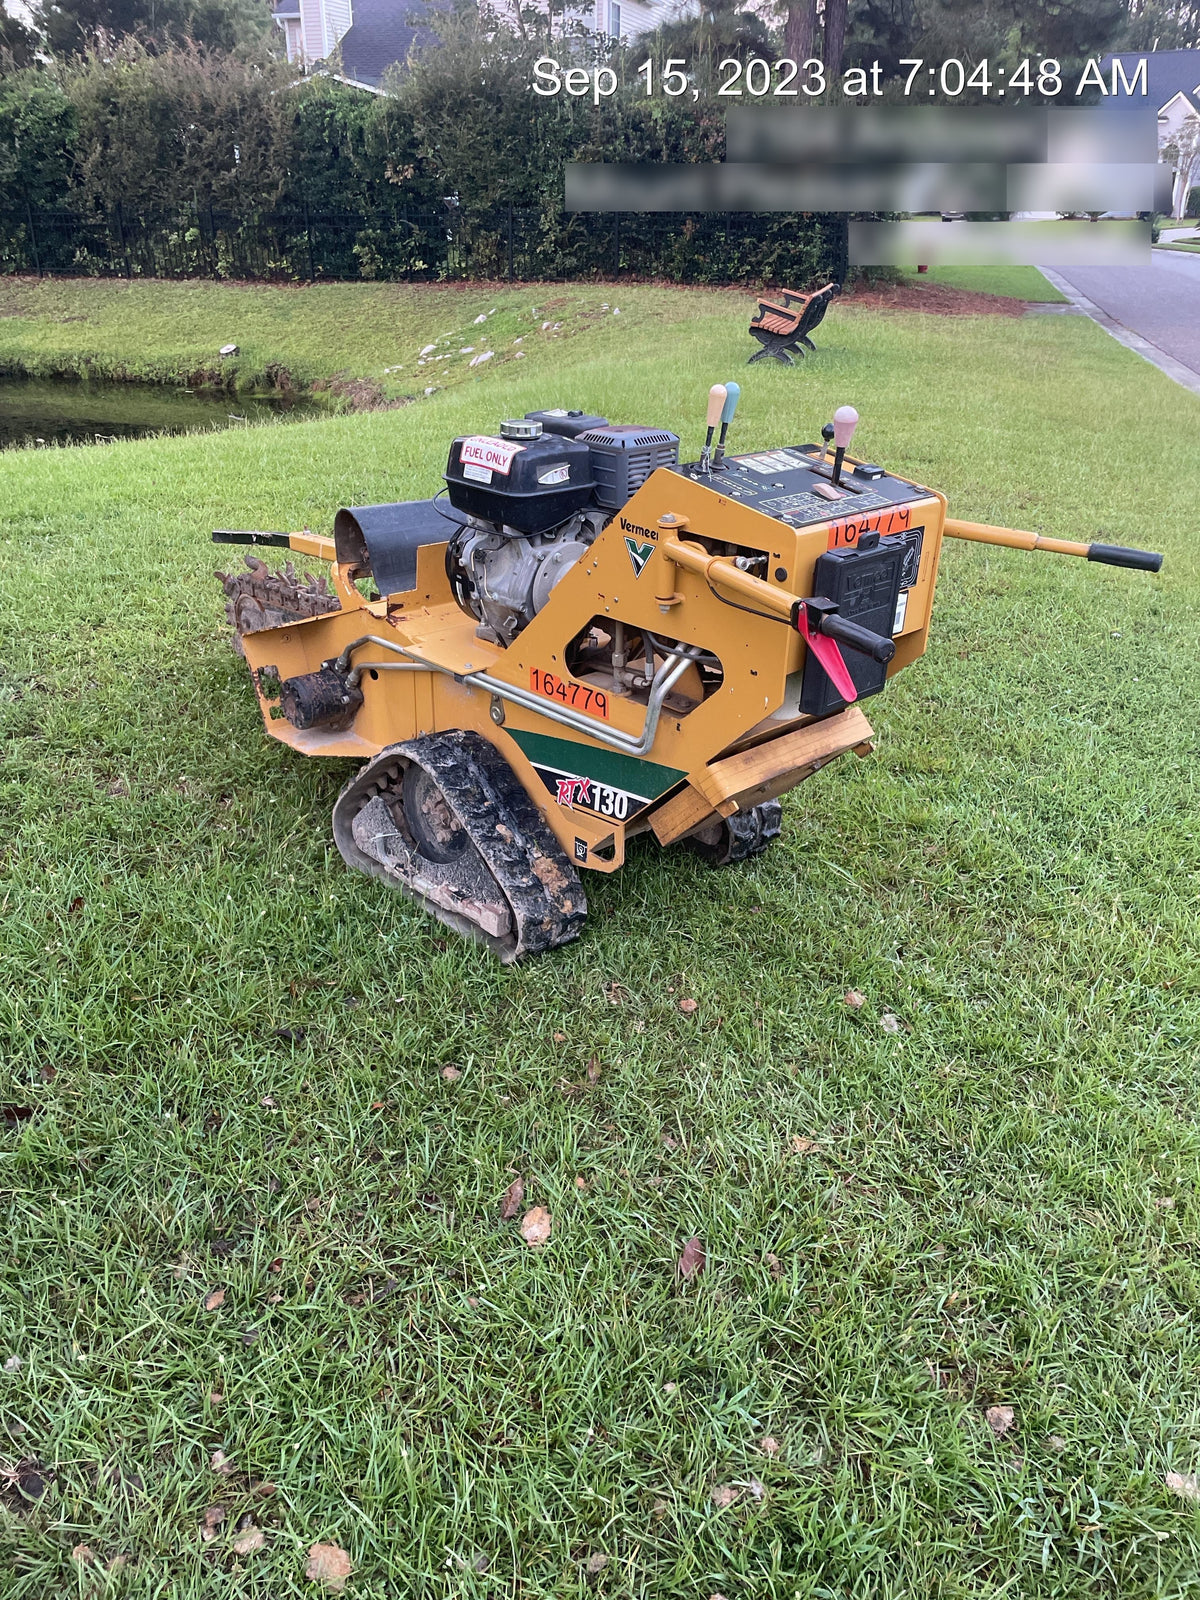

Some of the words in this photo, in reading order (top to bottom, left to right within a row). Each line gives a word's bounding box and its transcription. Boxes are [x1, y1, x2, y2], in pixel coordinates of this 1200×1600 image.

[464, 446, 483, 460] FUEL
[485, 450, 509, 467] ONLY
[531, 669, 607, 717] 164779
